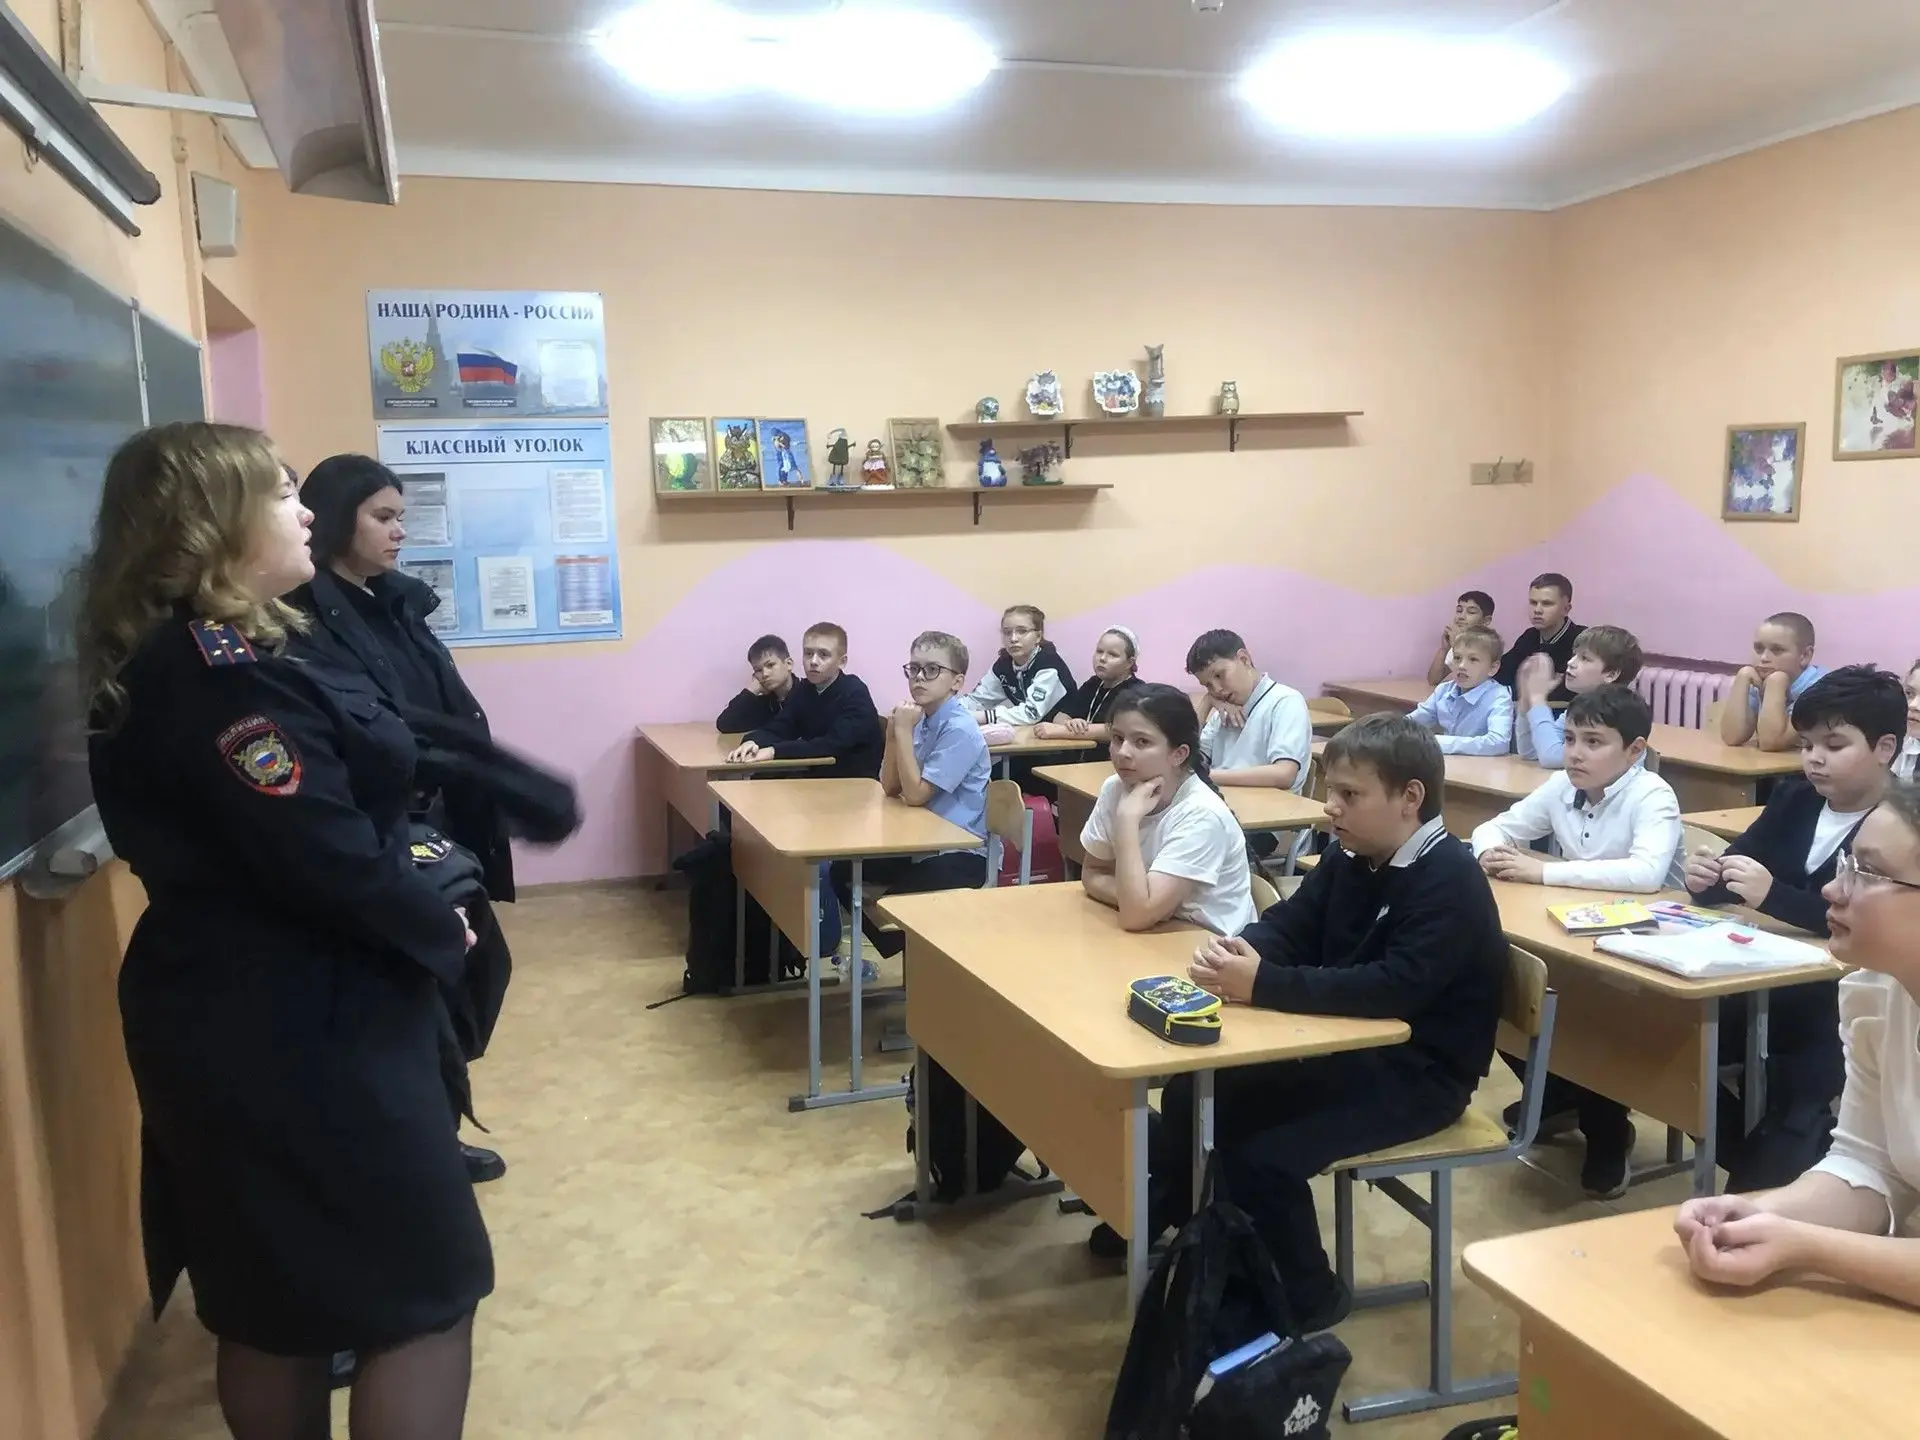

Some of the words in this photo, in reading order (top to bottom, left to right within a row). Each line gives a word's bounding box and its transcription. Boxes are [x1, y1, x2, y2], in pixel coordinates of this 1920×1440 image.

[377, 302, 432, 319] НАША
[436, 303, 510, 320] РОДИНА
[523, 304, 595, 321] РОССИЯ
[405, 436, 507, 455] КЛАССНЫЙ
[514, 437, 584, 454] УГОЛОК
